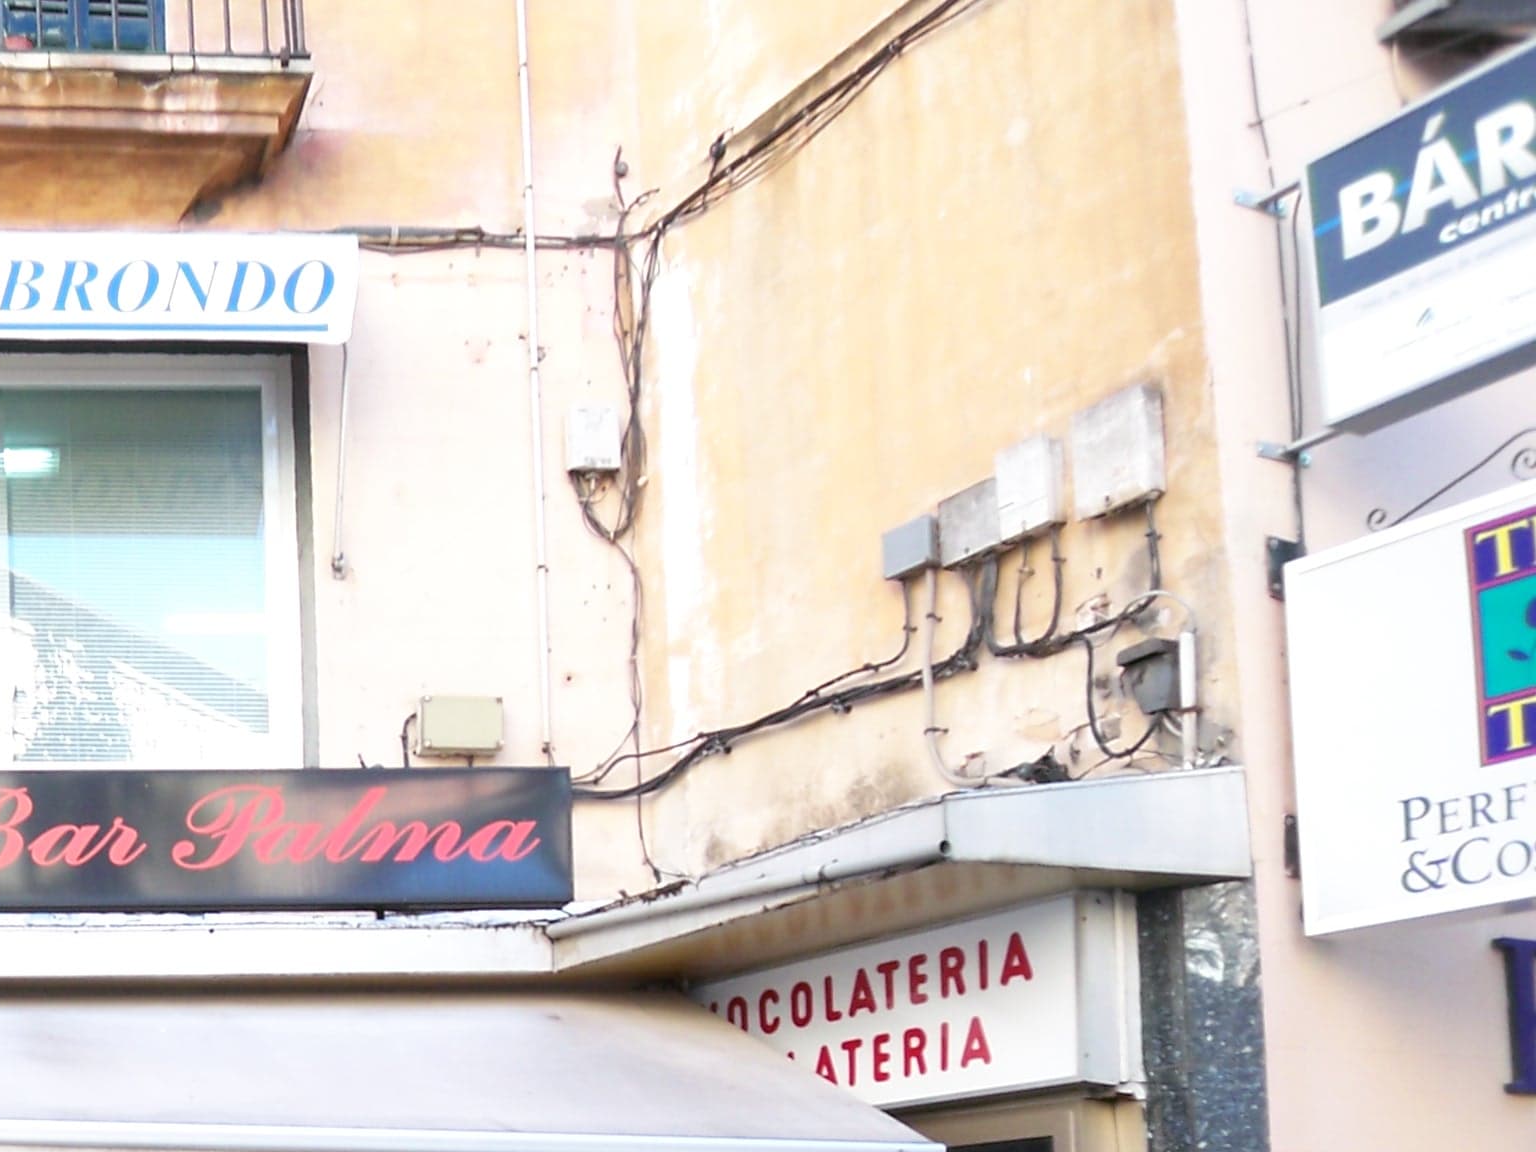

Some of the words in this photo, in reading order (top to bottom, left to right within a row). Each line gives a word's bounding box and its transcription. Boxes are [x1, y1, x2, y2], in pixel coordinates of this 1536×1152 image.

[171, 784, 541, 871] Palma
[1397, 780, 1536, 842] PERF
[706, 931, 1033, 1034] OCOLATERIA
[786, 1016, 992, 1087] ATERIA
